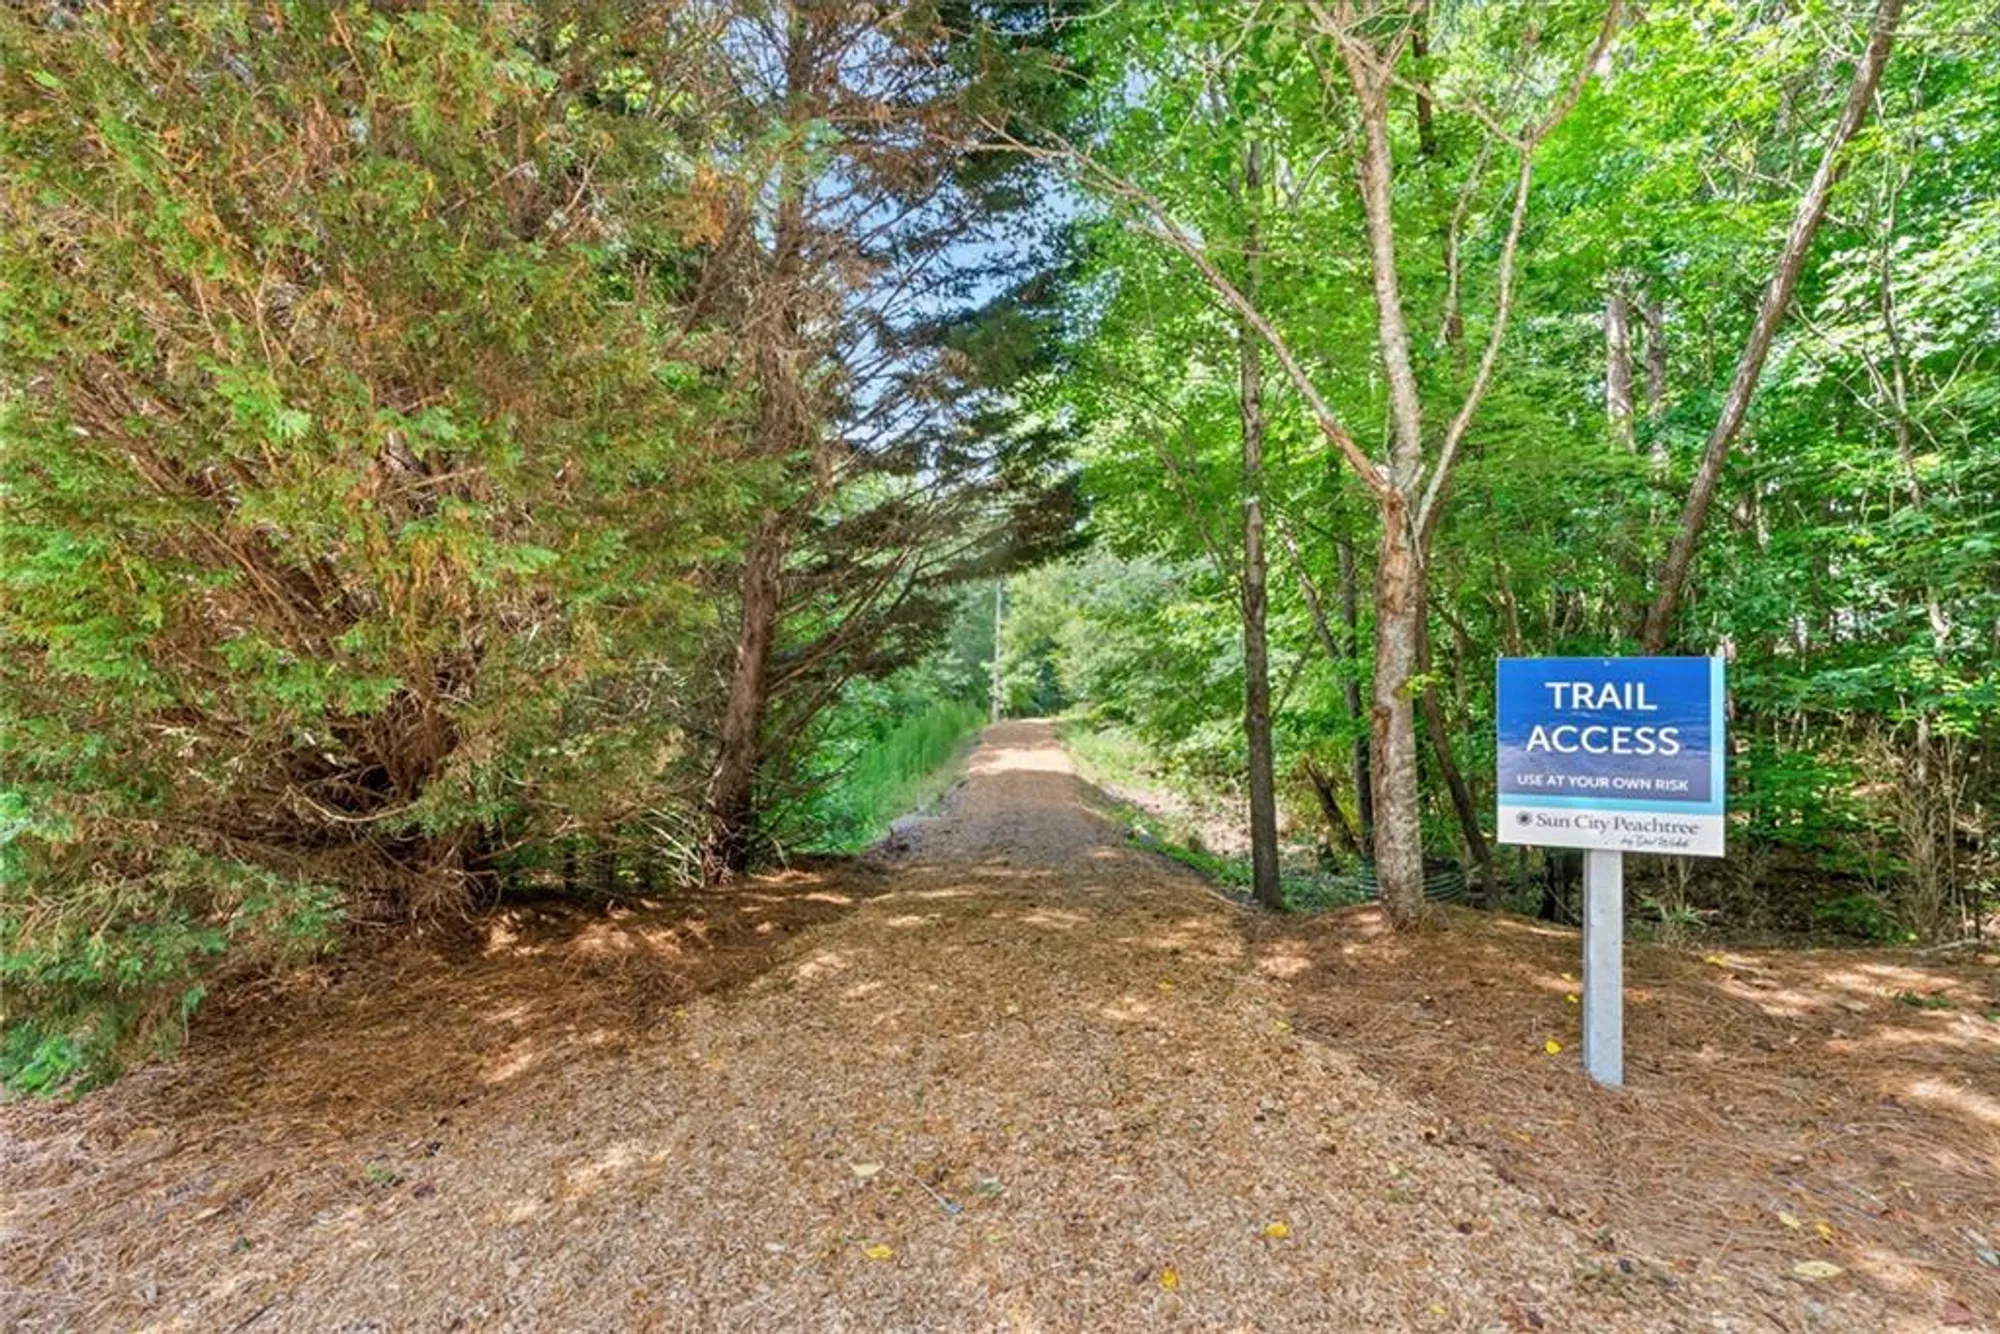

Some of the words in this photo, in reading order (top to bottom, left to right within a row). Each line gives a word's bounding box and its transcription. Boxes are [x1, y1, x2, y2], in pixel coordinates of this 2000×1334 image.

[1545, 682, 1657, 710] TRAIL
[1526, 725, 1679, 755] ACCESS
[1517, 775, 1544, 786] USE
[1547, 775, 1564, 786] AT
[1569, 776, 1610, 788] YOUR
[1614, 777, 1651, 790] OWN
[1655, 779, 1689, 791] RISK
[1536, 813, 1570, 828] Sun
[1575, 814, 1610, 834] City
[1614, 816, 1700, 834] Peachtree
